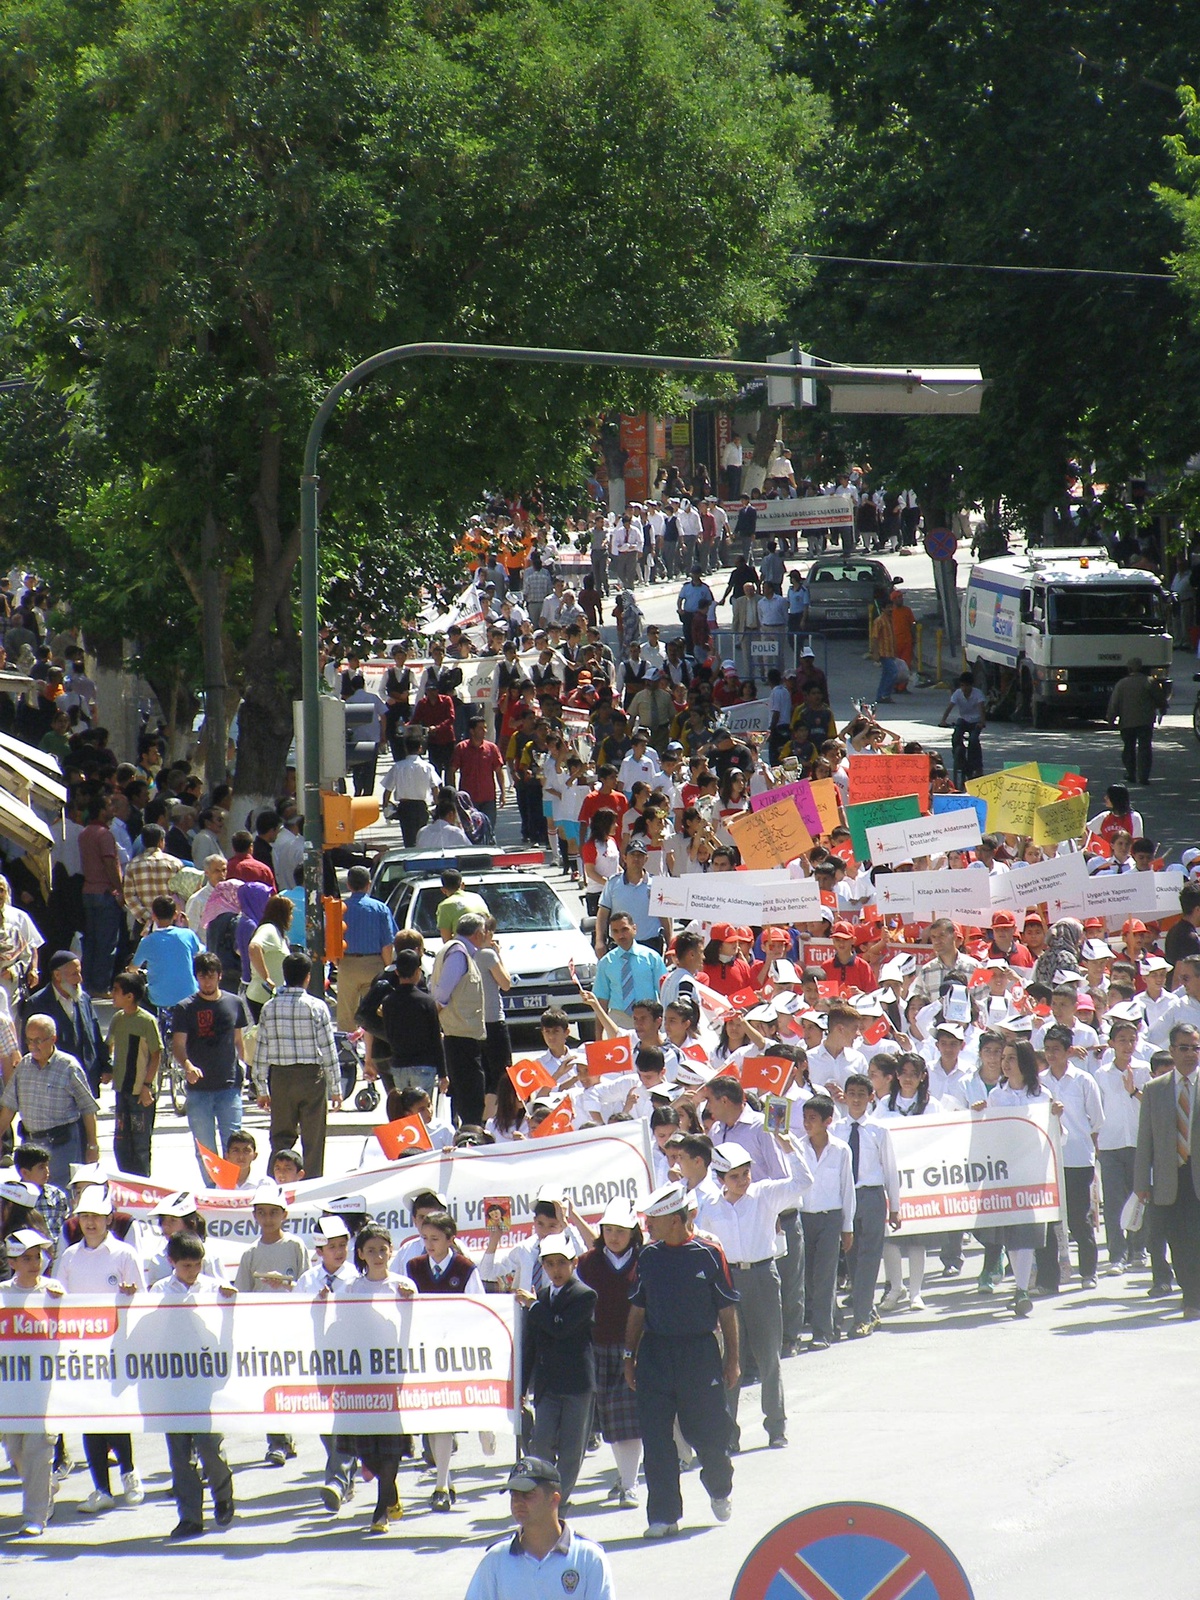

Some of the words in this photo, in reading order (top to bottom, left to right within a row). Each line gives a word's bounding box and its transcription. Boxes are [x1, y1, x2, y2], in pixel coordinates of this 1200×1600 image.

[752, 643, 776, 652] POLİS
[908, 831, 931, 841] Kitaplar
[944, 822, 977, 833] Aldatmayan
[910, 837, 940, 847] Dostlardır.
[1015, 878, 1040, 891] Uygarlık
[1016, 886, 1037, 897] Temeli
[1038, 881, 1062, 892] Kitaptır.
[1156, 886, 1182, 894] Okuduğu
[917, 888, 933, 897] Kitap
[934, 887, 950, 895] Aklın
[1086, 890, 1110, 900] Uygarlık
[691, 894, 715, 904] Kitaplar
[727, 897, 762, 907] Aldatmayan
[691, 902, 721, 910] Dostlardır.
[775, 896, 799, 905] Büyüyen
[800, 894, 818, 903] Çocuk
[1087, 898, 1107, 906] Temeli
[1108, 895, 1131, 904] Kitaptır.
[769, 905, 787, 913] Ağaca
[923, 1155, 1009, 1187] GİBİDİR
[943, 1194, 1012, 1215] İlköğretim
[1016, 1190, 1053, 1207] Okulu
[460, 1230, 528, 1250] Karaekir
[13, 1315, 109, 1339] Kampanyası
[40, 1348, 117, 1382] DEĞERİ
[125, 1347, 228, 1380] OKUDUĞU
[236, 1346, 362, 1377] KİTAPLARLA
[370, 1342, 427, 1375] BELLİ
[435, 1347, 493, 1372] OLUR
[274, 1391, 329, 1413] Hayrettin
[331, 1390, 394, 1411] Sönmezay
[396, 1386, 462, 1410] İlköğretim
[464, 1386, 500, 1405] Okulu
